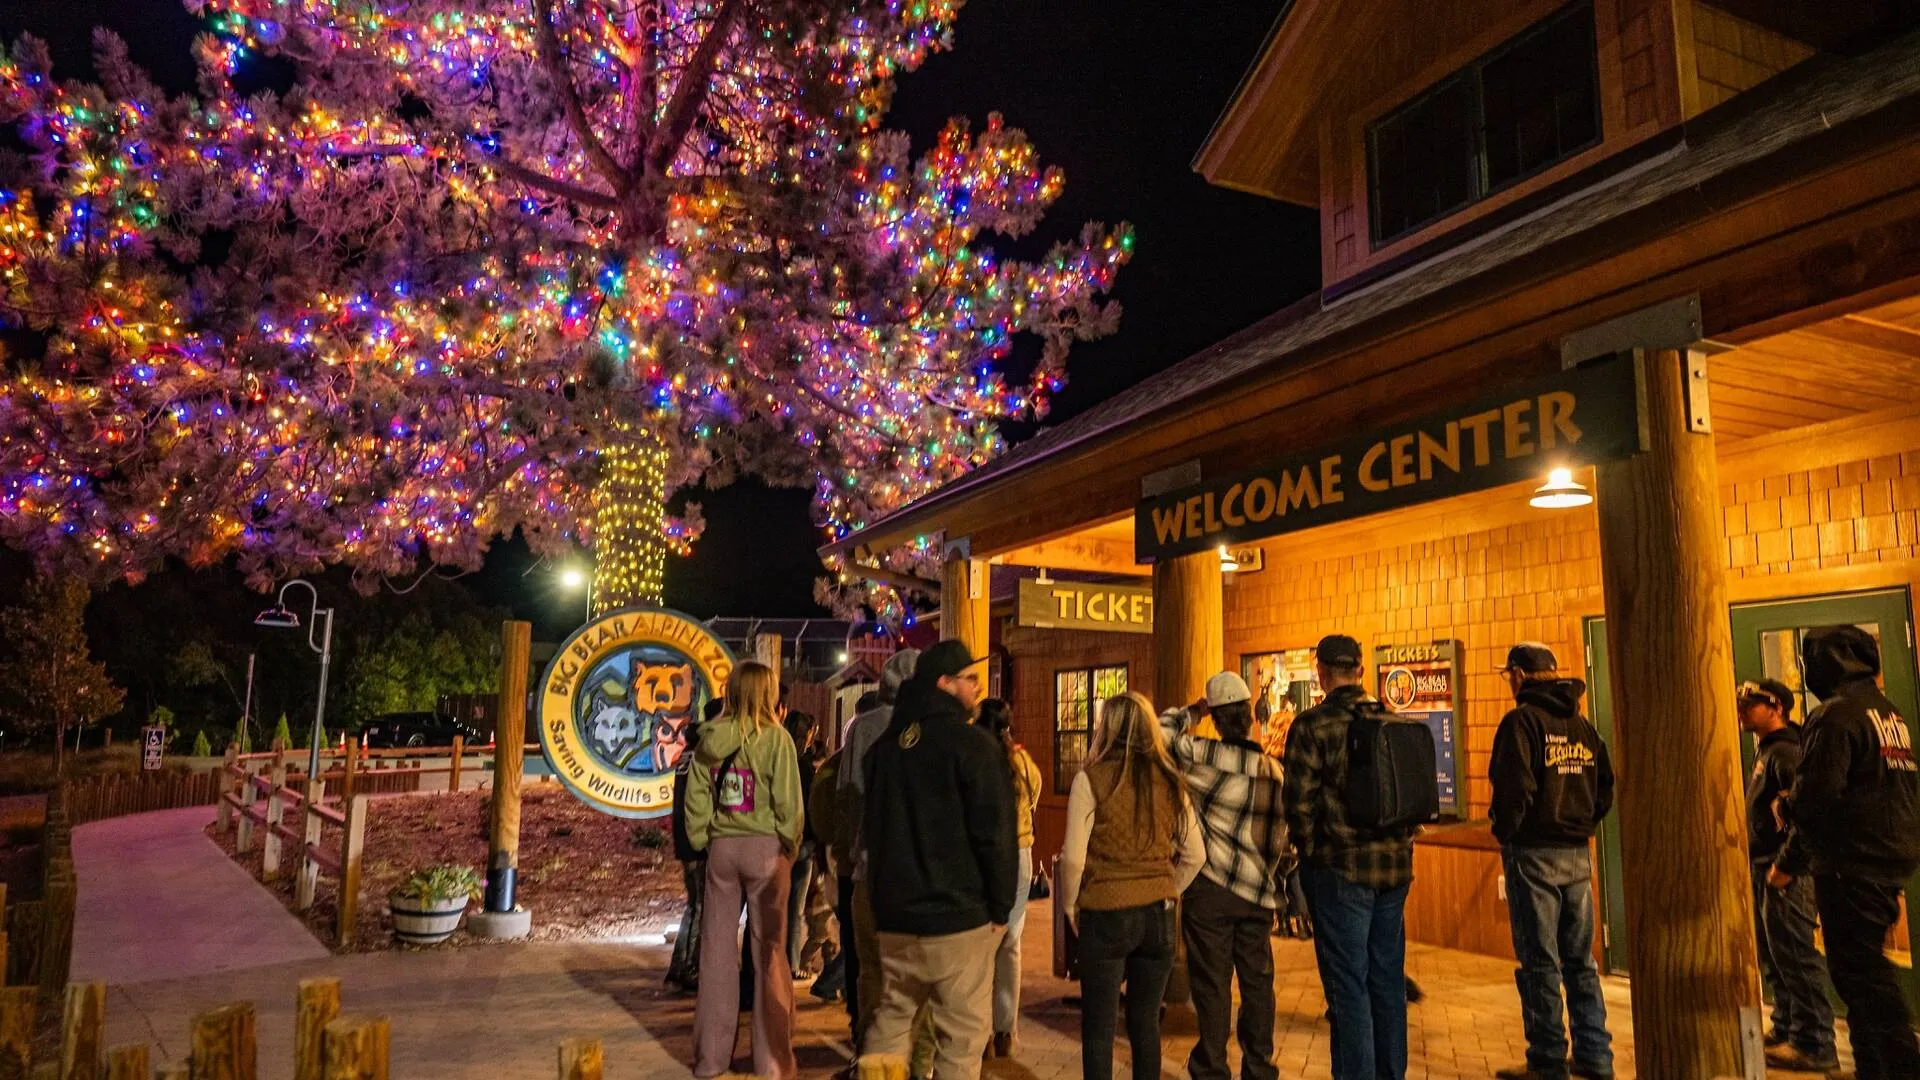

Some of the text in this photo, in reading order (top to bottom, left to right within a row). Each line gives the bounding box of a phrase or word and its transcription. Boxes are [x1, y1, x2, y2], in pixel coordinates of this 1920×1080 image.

[1152, 390, 1582, 545] WELCOME CENTER
[550, 660, 579, 697] BIG
[572, 619, 626, 662] BEAR
[631, 614, 710, 648] ALPINE
[1383, 645, 1439, 663] TICKETS
[550, 719, 586, 781] Saving
[587, 773, 652, 803] Wildlife
